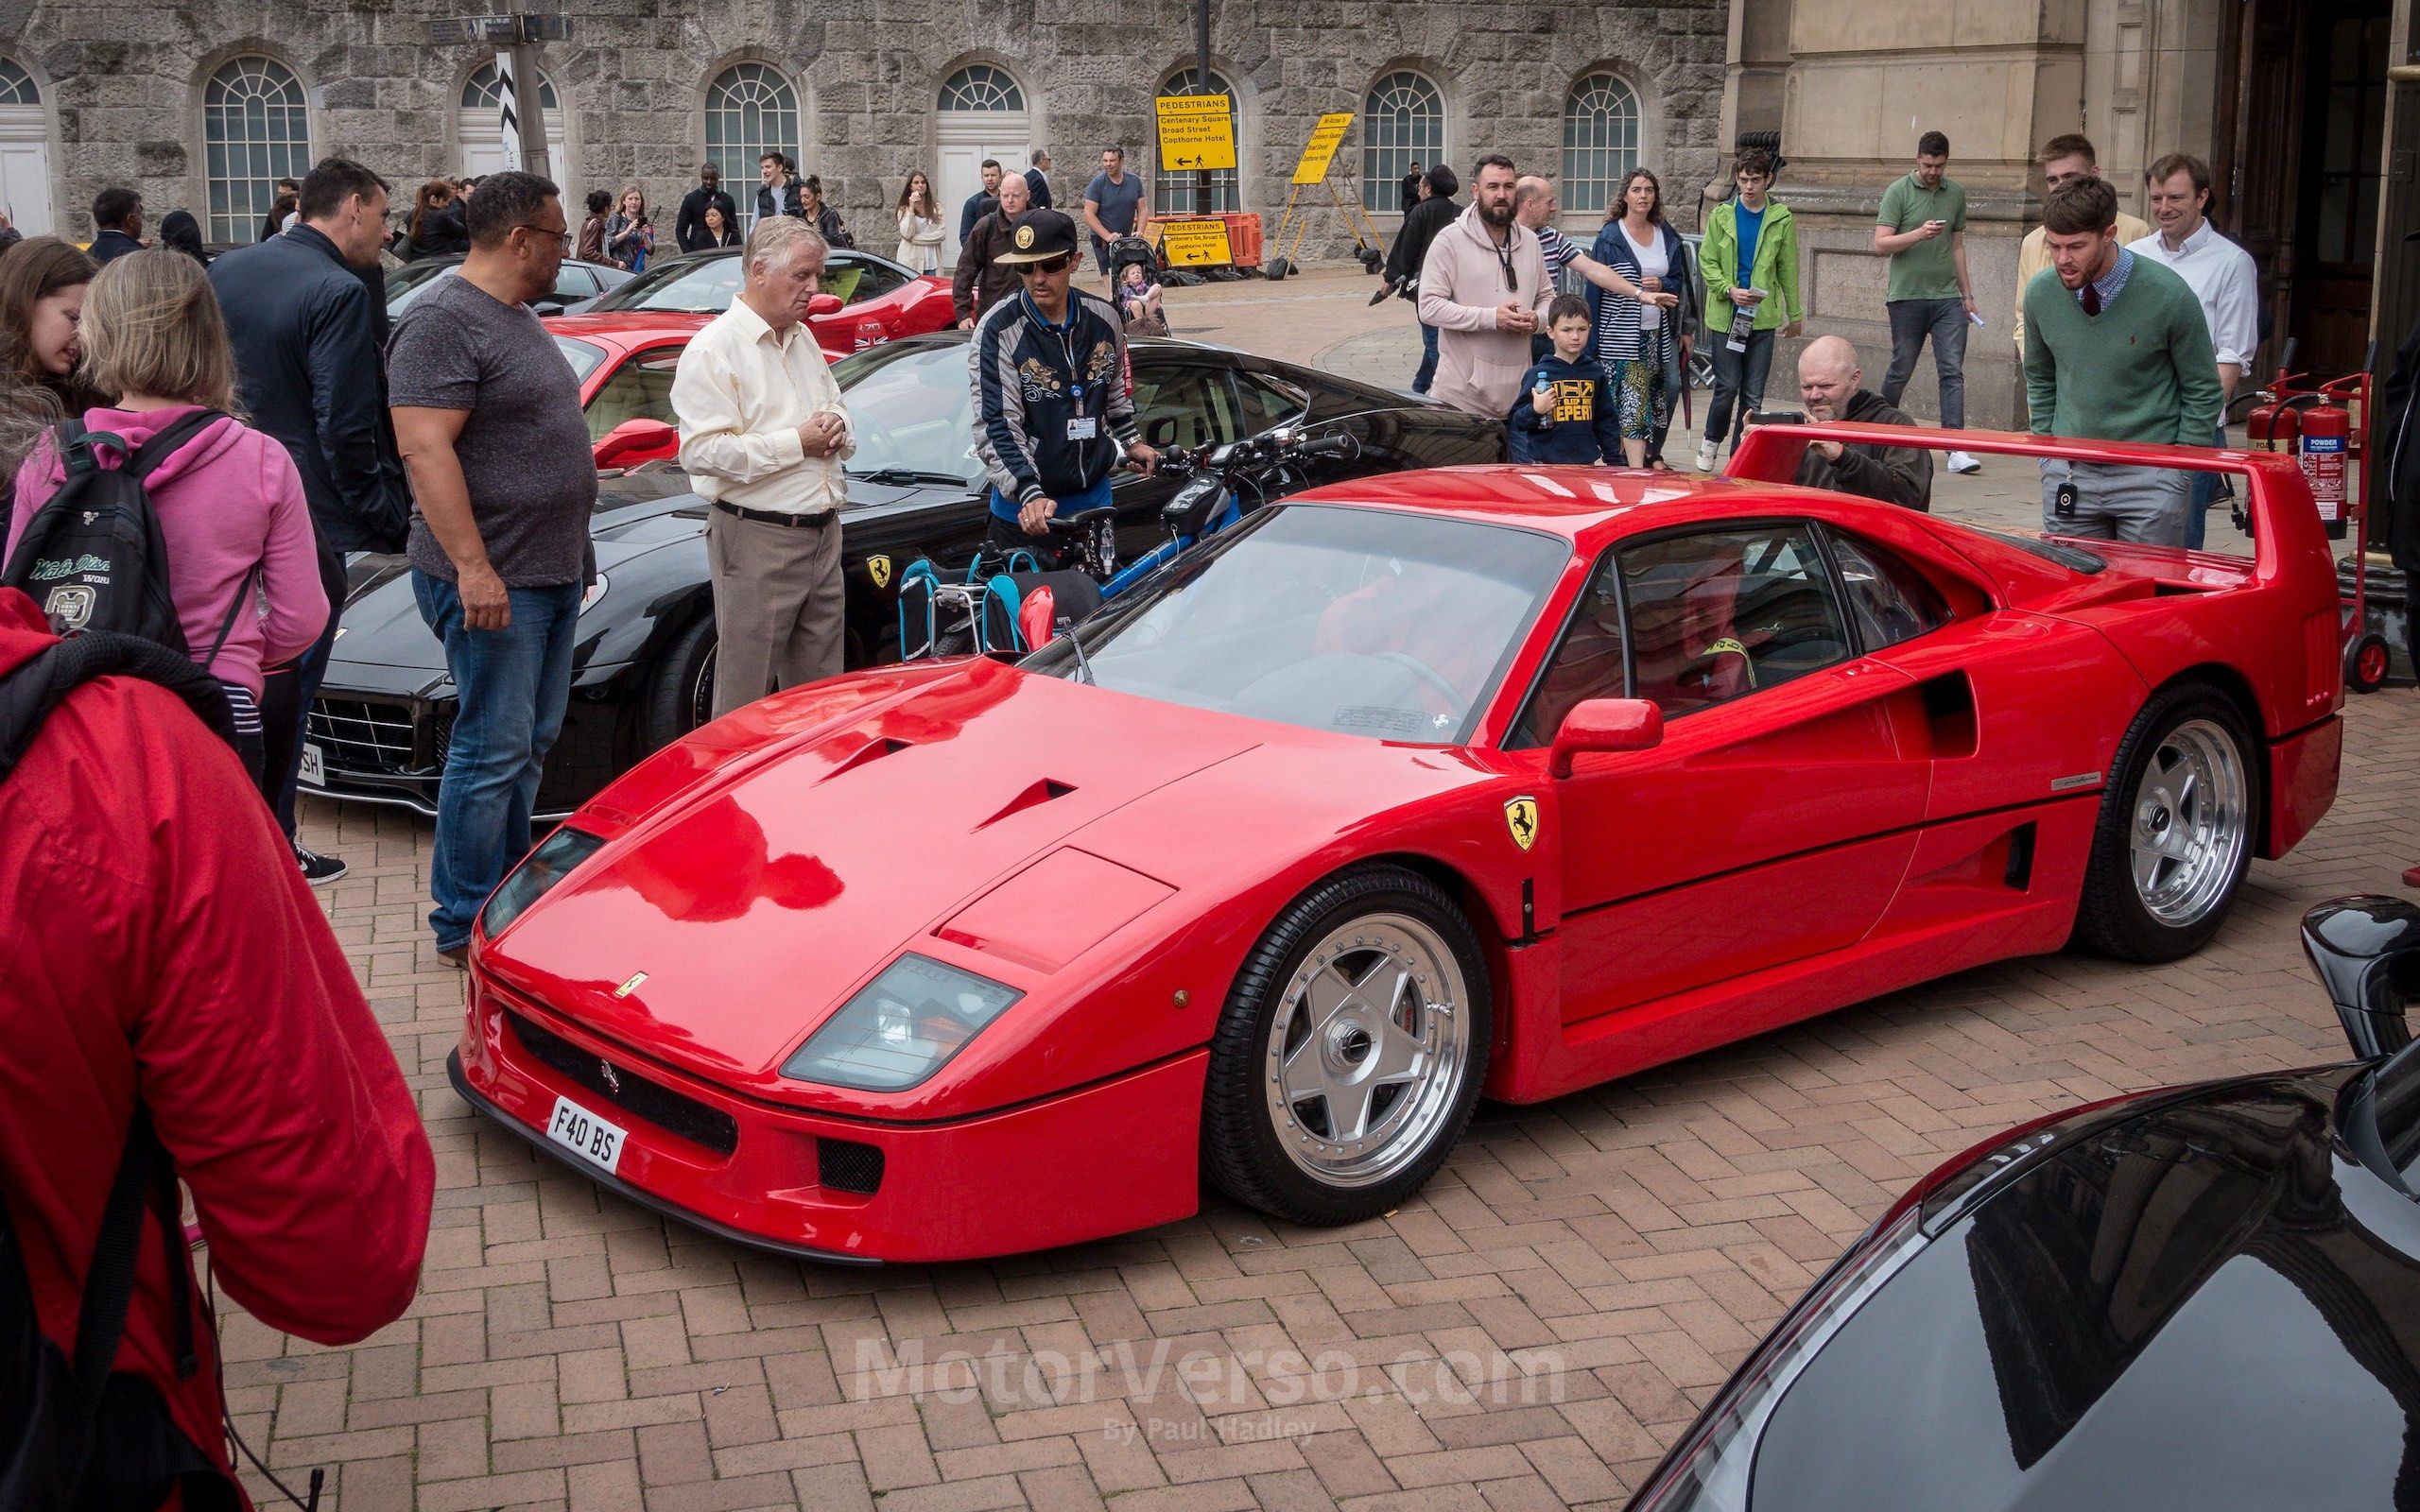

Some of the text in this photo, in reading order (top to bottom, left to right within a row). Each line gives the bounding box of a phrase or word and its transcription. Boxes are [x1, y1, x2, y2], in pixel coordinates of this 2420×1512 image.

[1160, 99, 1226, 110] PEDESTRIANS
[1161, 116, 1200, 125] Centenary
[1167, 223, 1220, 232] PEDESTRIANS
[29, 558, 74, 580] Walt
[554, 1105, 614, 1161] F40 BS
